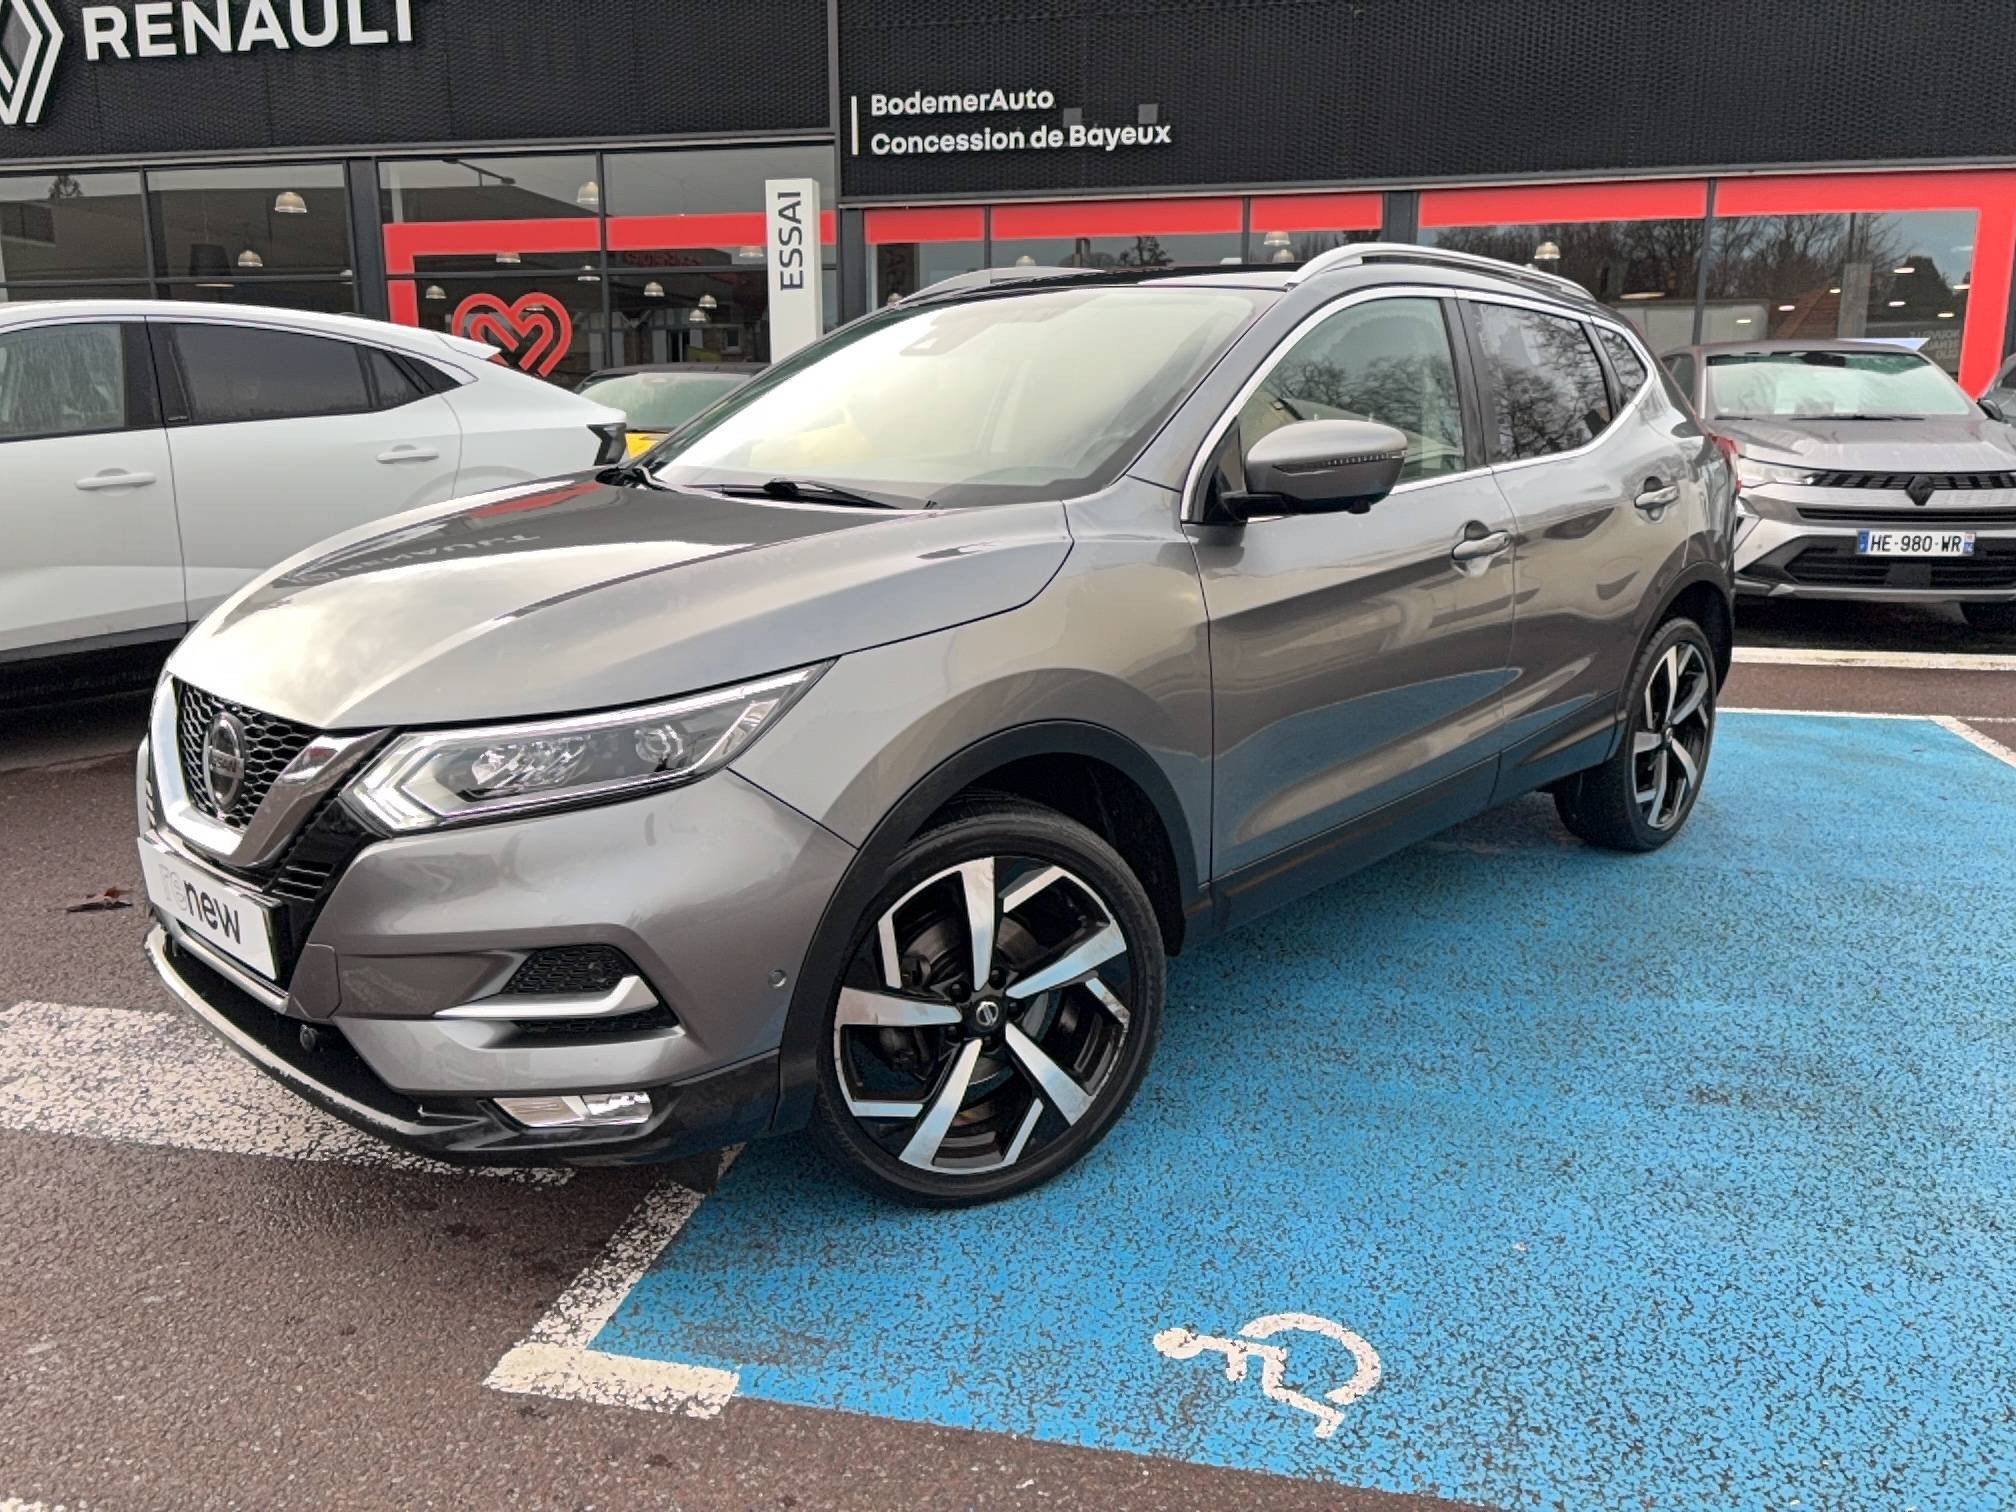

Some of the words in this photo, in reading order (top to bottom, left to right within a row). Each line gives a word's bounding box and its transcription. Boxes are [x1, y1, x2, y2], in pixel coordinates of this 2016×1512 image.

[871, 88, 1055, 116] BodemerAuto
[871, 127, 1025, 155] Concession
[1029, 125, 1064, 149] de
[1069, 124, 1172, 152] Bayeux
[777, 191, 804, 291] ESSAI
